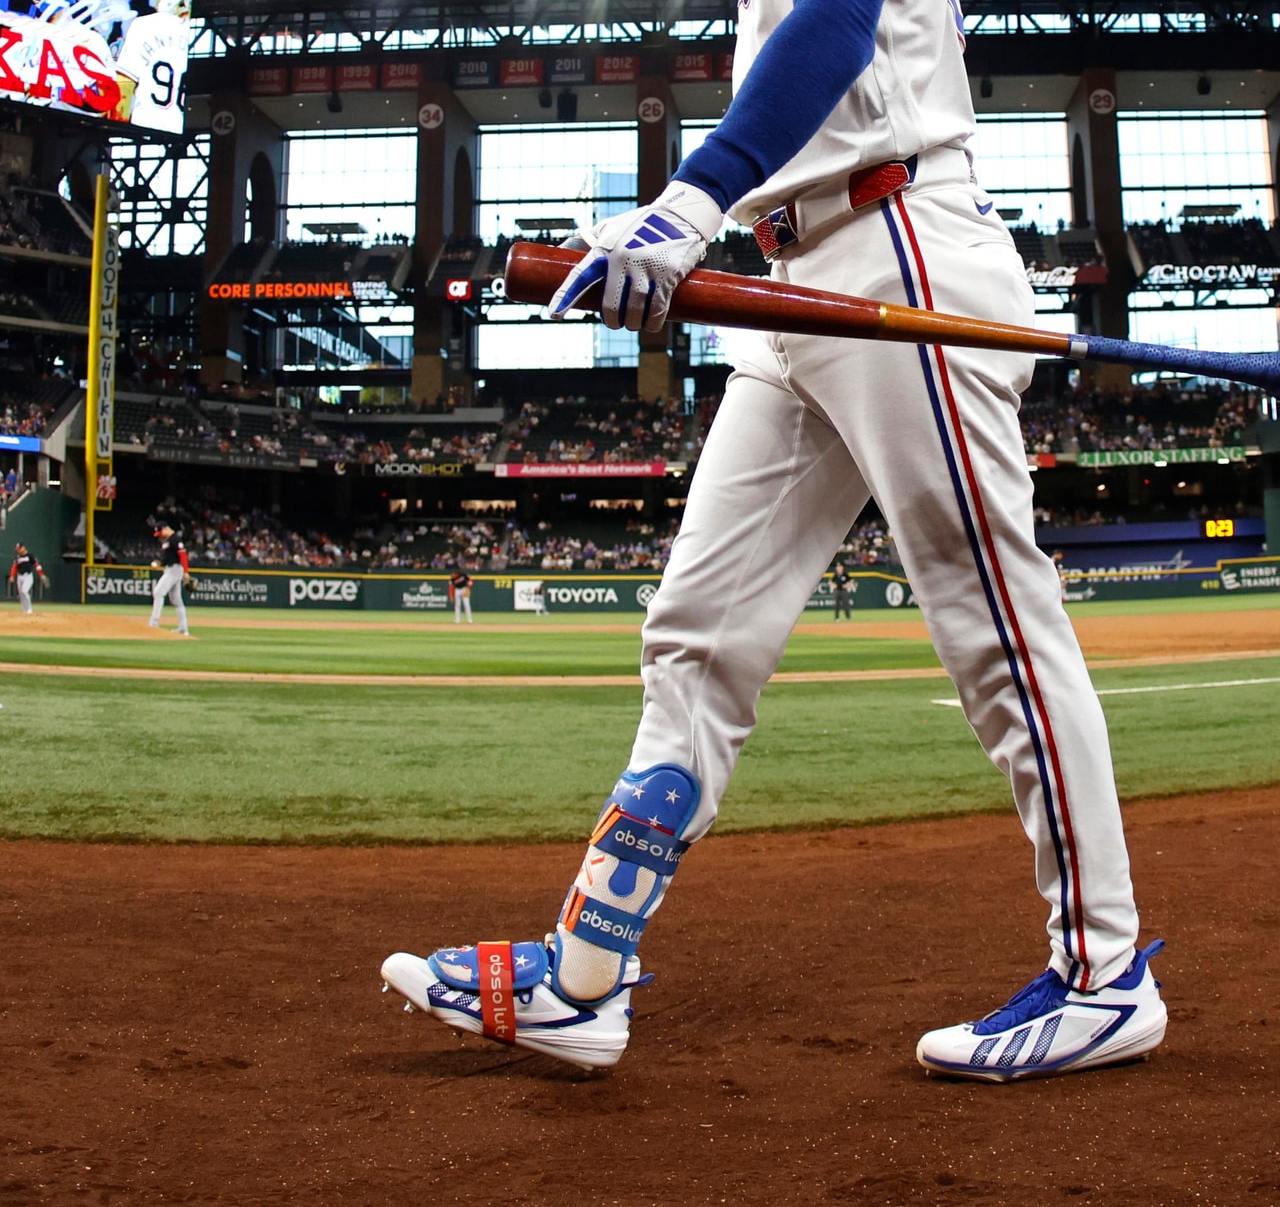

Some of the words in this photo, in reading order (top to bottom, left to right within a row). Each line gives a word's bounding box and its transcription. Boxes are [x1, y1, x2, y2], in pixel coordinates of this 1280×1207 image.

[508, 60, 535, 73] 2011
[555, 59, 581, 71] 2011
[603, 56, 632, 69] 2012
[675, 54, 706, 67] 2015
[343, 65, 370, 78] 1999
[389, 64, 417, 77] 2010
[459, 61, 488, 74] 2010
[1092, 95, 1113, 108] 29
[422, 109, 442, 124] 34
[642, 104, 662, 118] 26
[214, 116, 233, 131] 42
[1161, 264, 1257, 281] CHOCTAW
[209, 284, 252, 299] CORE
[255, 281, 352, 298] PERSONNEL
[352, 281, 387, 289] STAFFING
[448, 280, 469, 297] QT
[1095, 451, 1154, 466] LUXOR
[1159, 447, 1243, 464] STAFFING
[375, 463, 464, 476] MOONSHOT
[520, 464, 573, 475] America's
[577, 464, 603, 474] Best
[603, 463, 653, 474] Network
[87, 576, 157, 595] SEATGEE
[196, 578, 268, 595] ailey&Galyen
[289, 578, 359, 606] paze
[548, 588, 619, 604] TOYOTA
